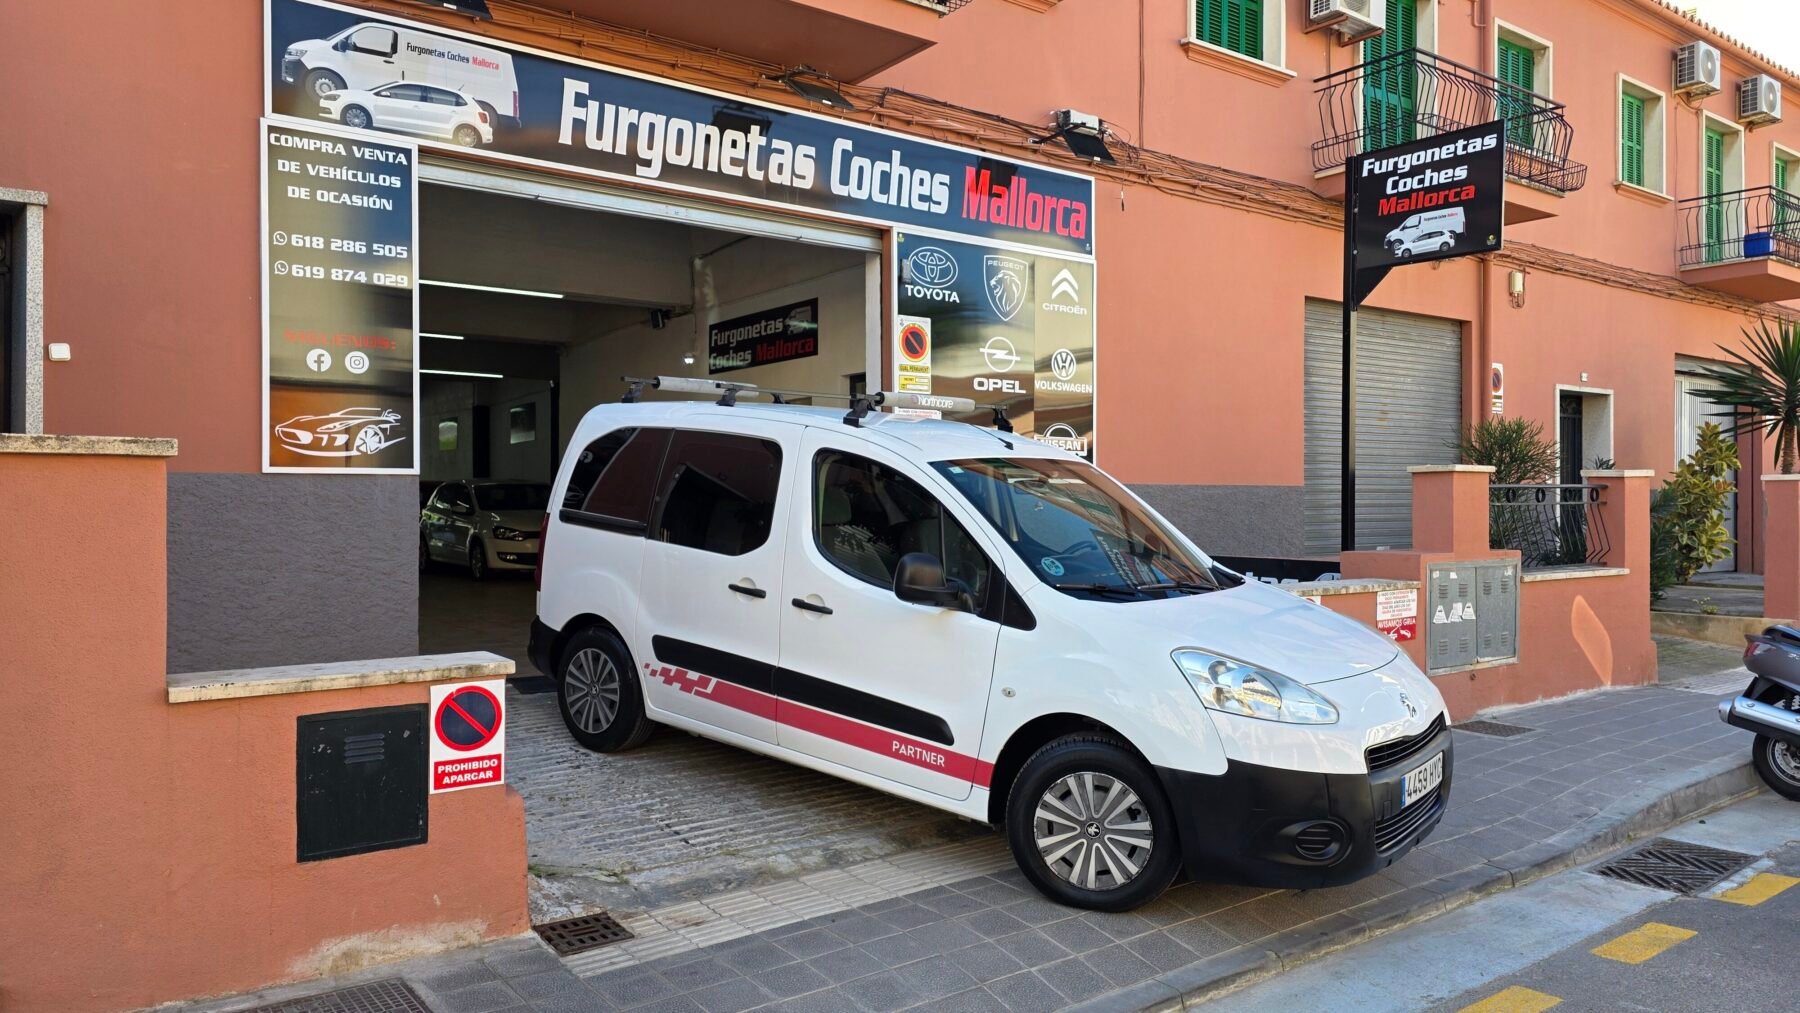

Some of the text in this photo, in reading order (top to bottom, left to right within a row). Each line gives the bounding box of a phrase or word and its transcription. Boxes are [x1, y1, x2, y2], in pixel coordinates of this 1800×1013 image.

[407, 42, 499, 70] Furgonetas Coches Mallorca
[269, 133, 408, 165] COMPRA VENTA
[558, 77, 1086, 239] Furgonetas Coches Mallorca
[1362, 133, 1497, 177] Furgonetas
[277, 159, 401, 188] DE VEHÍCULOS
[1386, 165, 1468, 195] Coches
[287, 185, 393, 211] DE OCASIÓN
[1378, 184, 1476, 216] Mallorca
[291, 234, 408, 259] 618 286 505
[291, 264, 409, 287] 619 874 029
[988, 260, 1025, 271] PEUGEOT
[905, 284, 960, 303] TOYOTA
[711, 318, 784, 347] Furgonetas
[709, 338, 814, 370] Coches Mallorca
[973, 377, 1027, 394] OPEL
[1034, 380, 1092, 393] VOLKSWAGEN
[437, 759, 498, 774] PROHIBIDO
[892, 740, 945, 767] PARTNER
[442, 770, 493, 784] APARCAR
[1406, 767, 1427, 799] 4459
